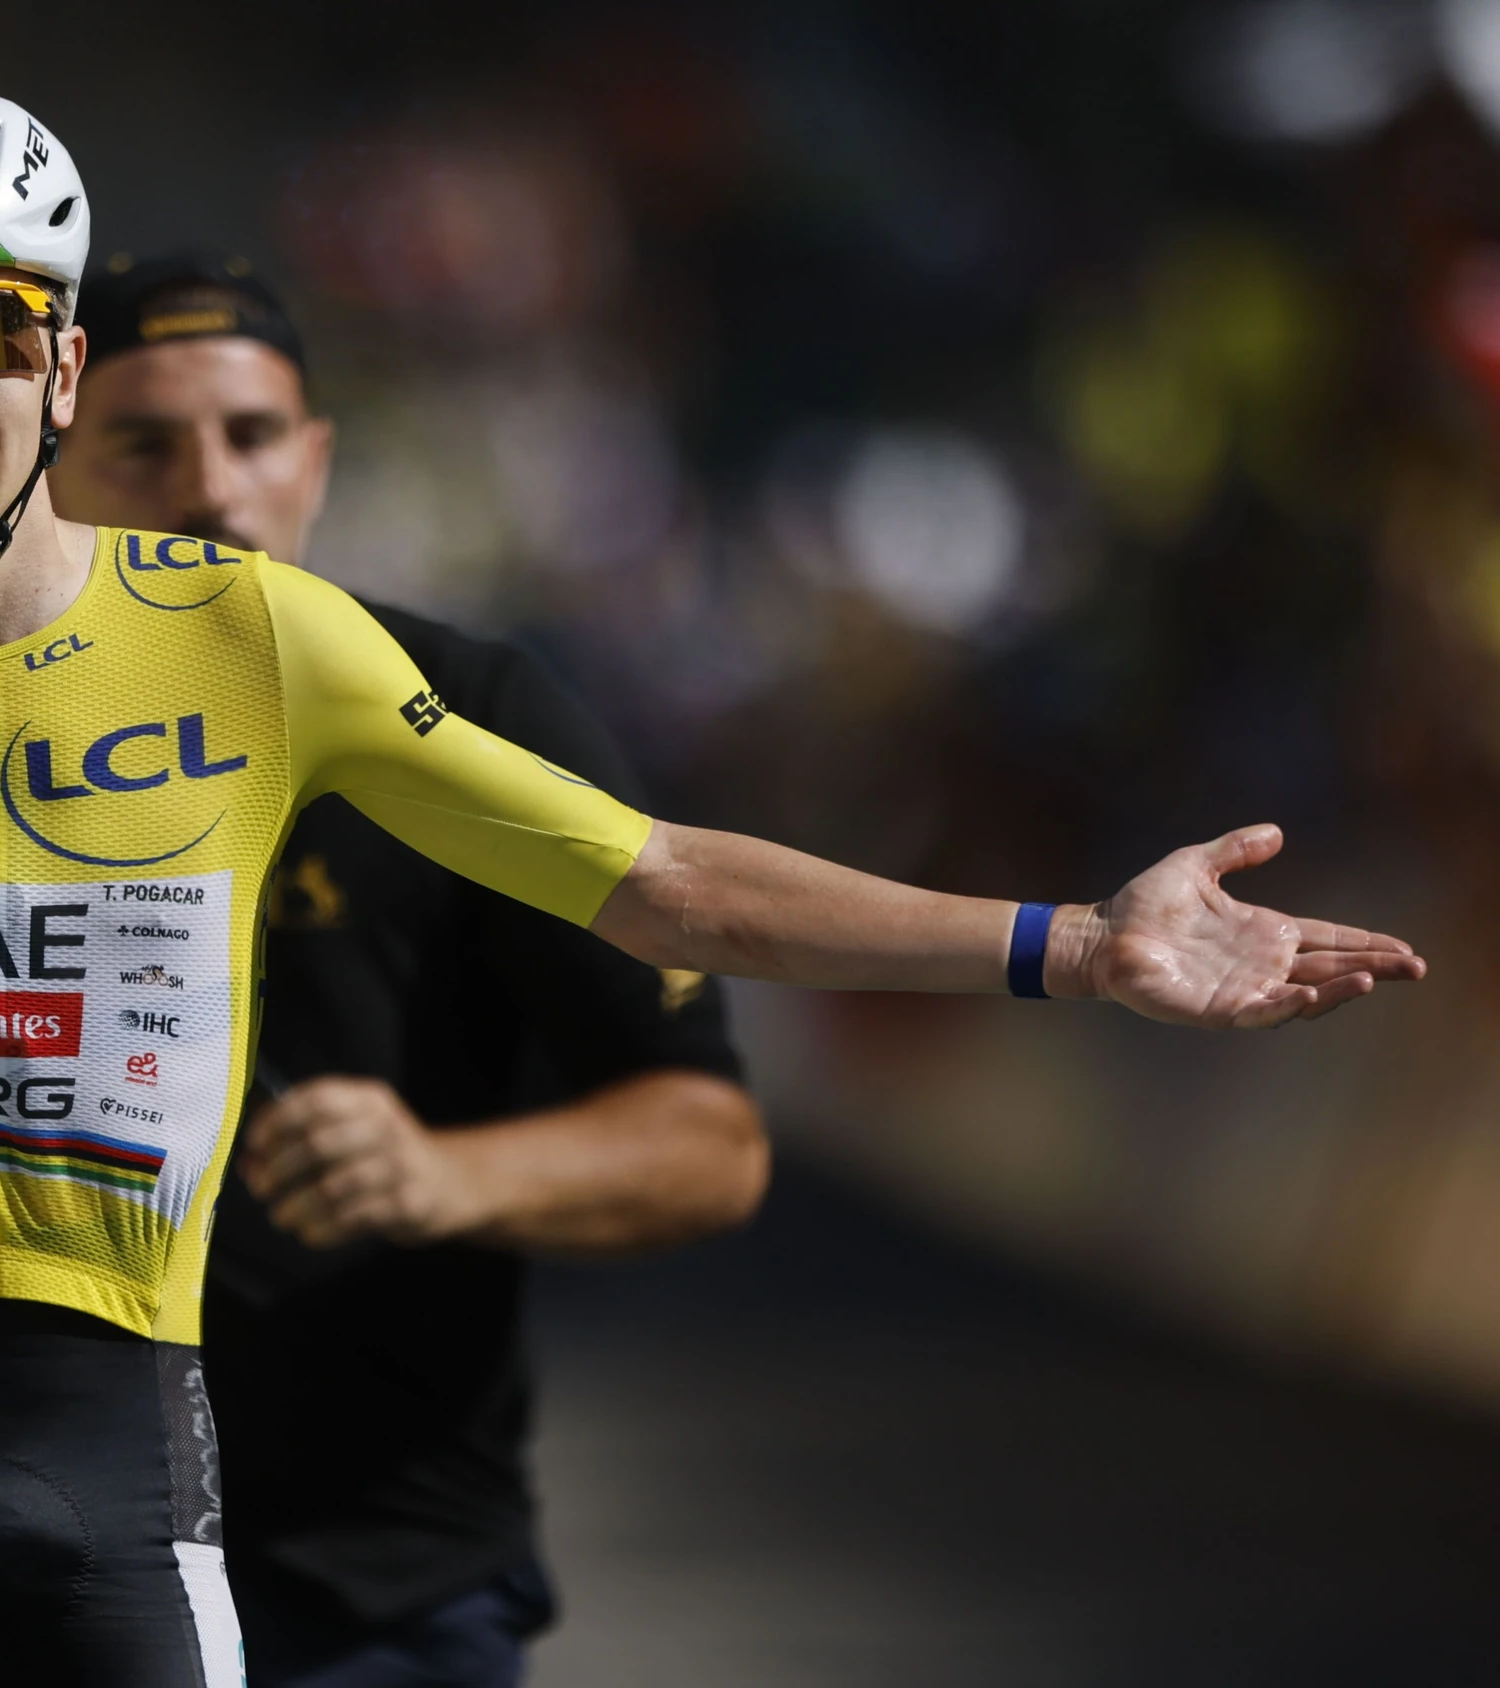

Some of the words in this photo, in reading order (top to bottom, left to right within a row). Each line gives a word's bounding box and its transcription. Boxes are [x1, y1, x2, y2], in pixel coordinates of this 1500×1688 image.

[12, 117, 49, 201] MET
[127, 535, 241, 572] LCL
[24, 633, 94, 671] LCL
[25, 712, 248, 801] LCL
[103, 885, 117, 901] T.
[124, 885, 204, 905] POGACAR
[132, 927, 190, 940] COLNAGO
[143, 1012, 181, 1038] IHC
[115, 1103, 164, 1124] PISSEI
